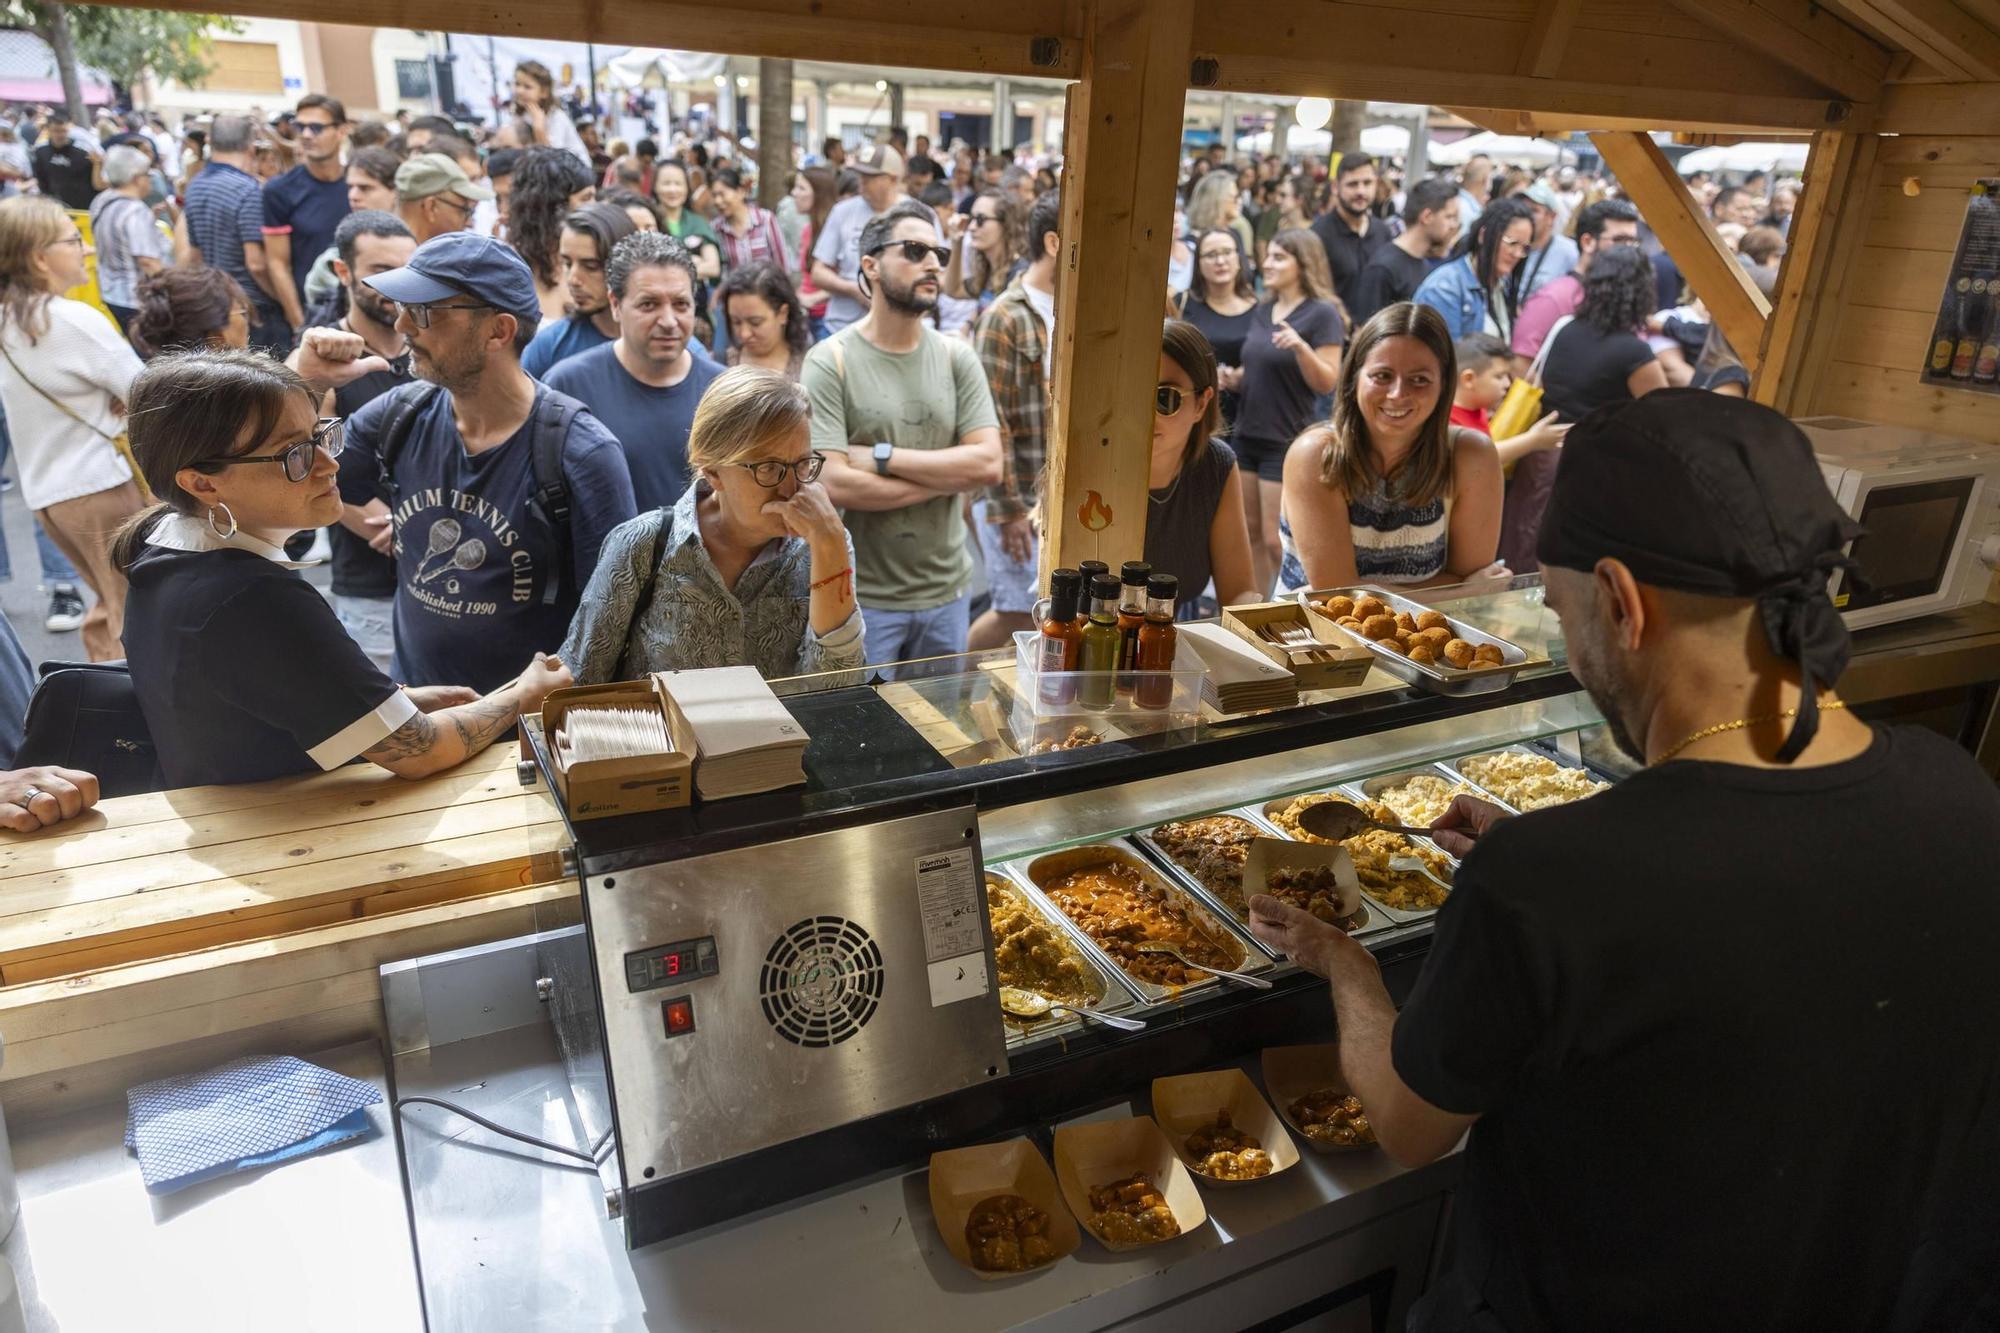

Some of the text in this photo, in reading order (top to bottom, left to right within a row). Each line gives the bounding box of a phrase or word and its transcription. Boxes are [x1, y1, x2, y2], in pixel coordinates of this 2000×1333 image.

[394, 487, 443, 553] MIUM
[450, 489, 519, 547] TENNIS
[465, 601, 497, 615] 1990
[667, 954, 680, 976] 3
